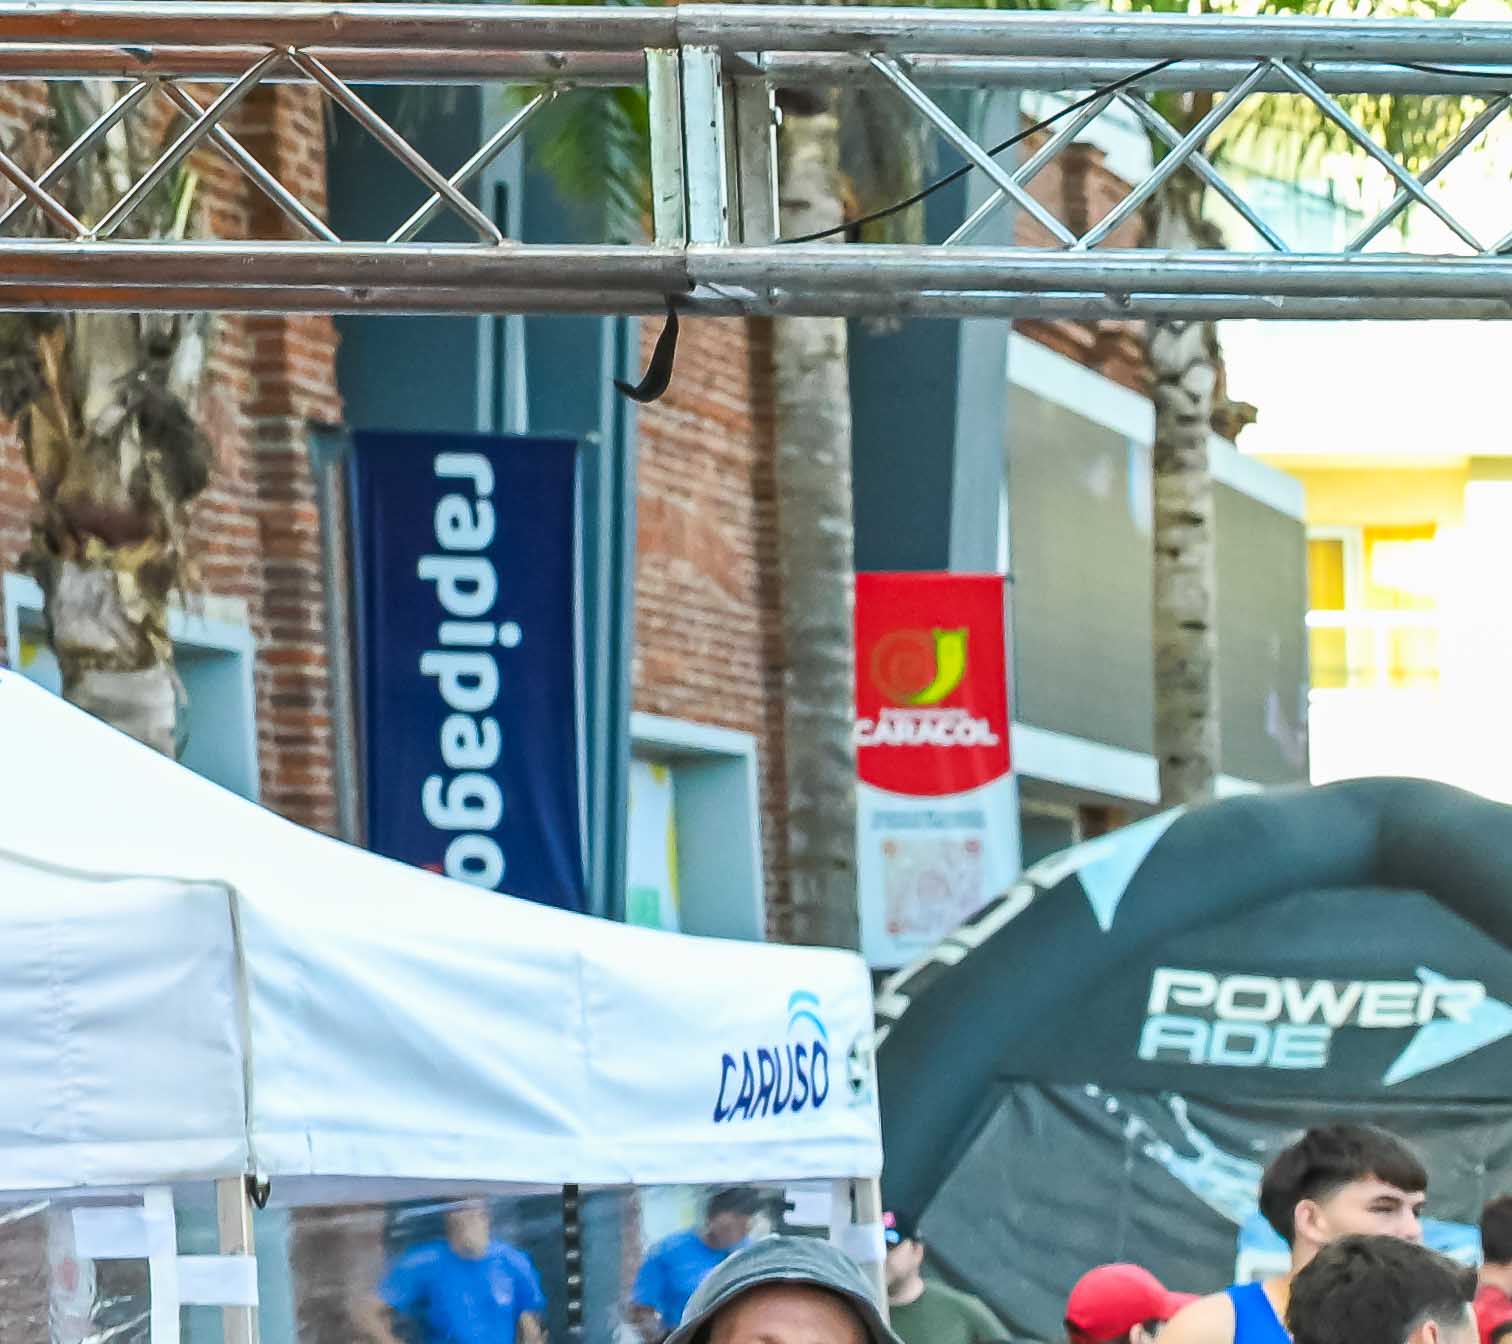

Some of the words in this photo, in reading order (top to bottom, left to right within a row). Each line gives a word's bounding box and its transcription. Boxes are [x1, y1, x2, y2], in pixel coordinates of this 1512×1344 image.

[416, 452, 523, 893] rapipago
[855, 718, 1000, 748] CARACOL
[1147, 966, 1487, 1028] POWER
[1137, 1014, 1333, 1069] ADE
[712, 1039, 830, 1123] CARUSO
